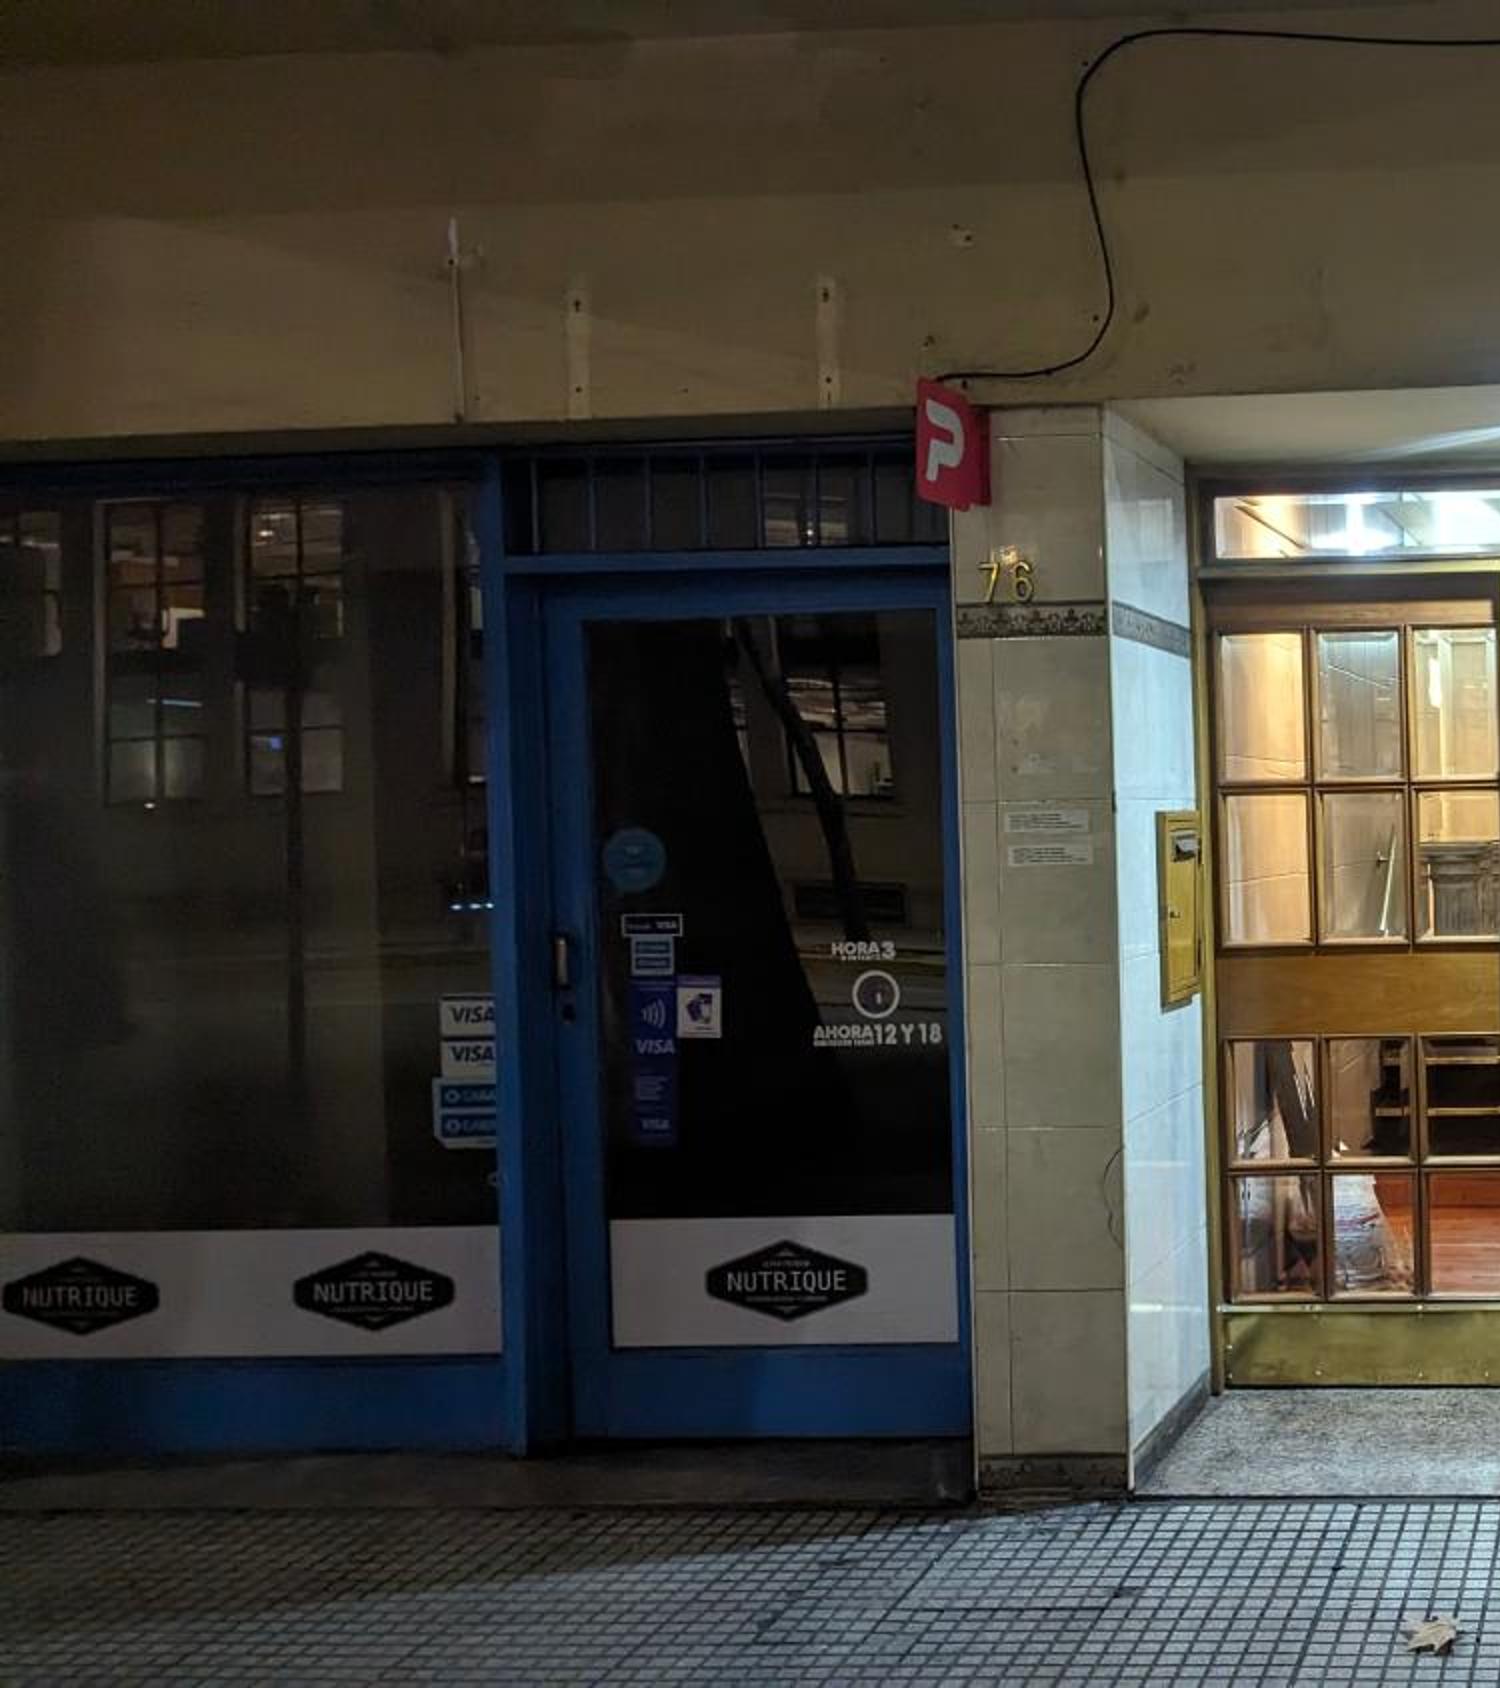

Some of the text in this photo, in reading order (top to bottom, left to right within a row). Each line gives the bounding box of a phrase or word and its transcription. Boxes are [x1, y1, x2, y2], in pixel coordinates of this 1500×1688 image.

[977, 561, 1036, 604] 76
[450, 1006, 496, 1023] VISA
[900, 1023, 914, 1045] Y
[918, 1023, 943, 1045] 18
[450, 1045, 496, 1062] VISA
[636, 1039, 675, 1055] VISA
[640, 1119, 670, 1132] VISA
[313, 1279, 433, 1304] NUTRIQUE
[726, 1269, 849, 1294] NUTRIQUE
[22, 1285, 138, 1308] NUTRIQUE
